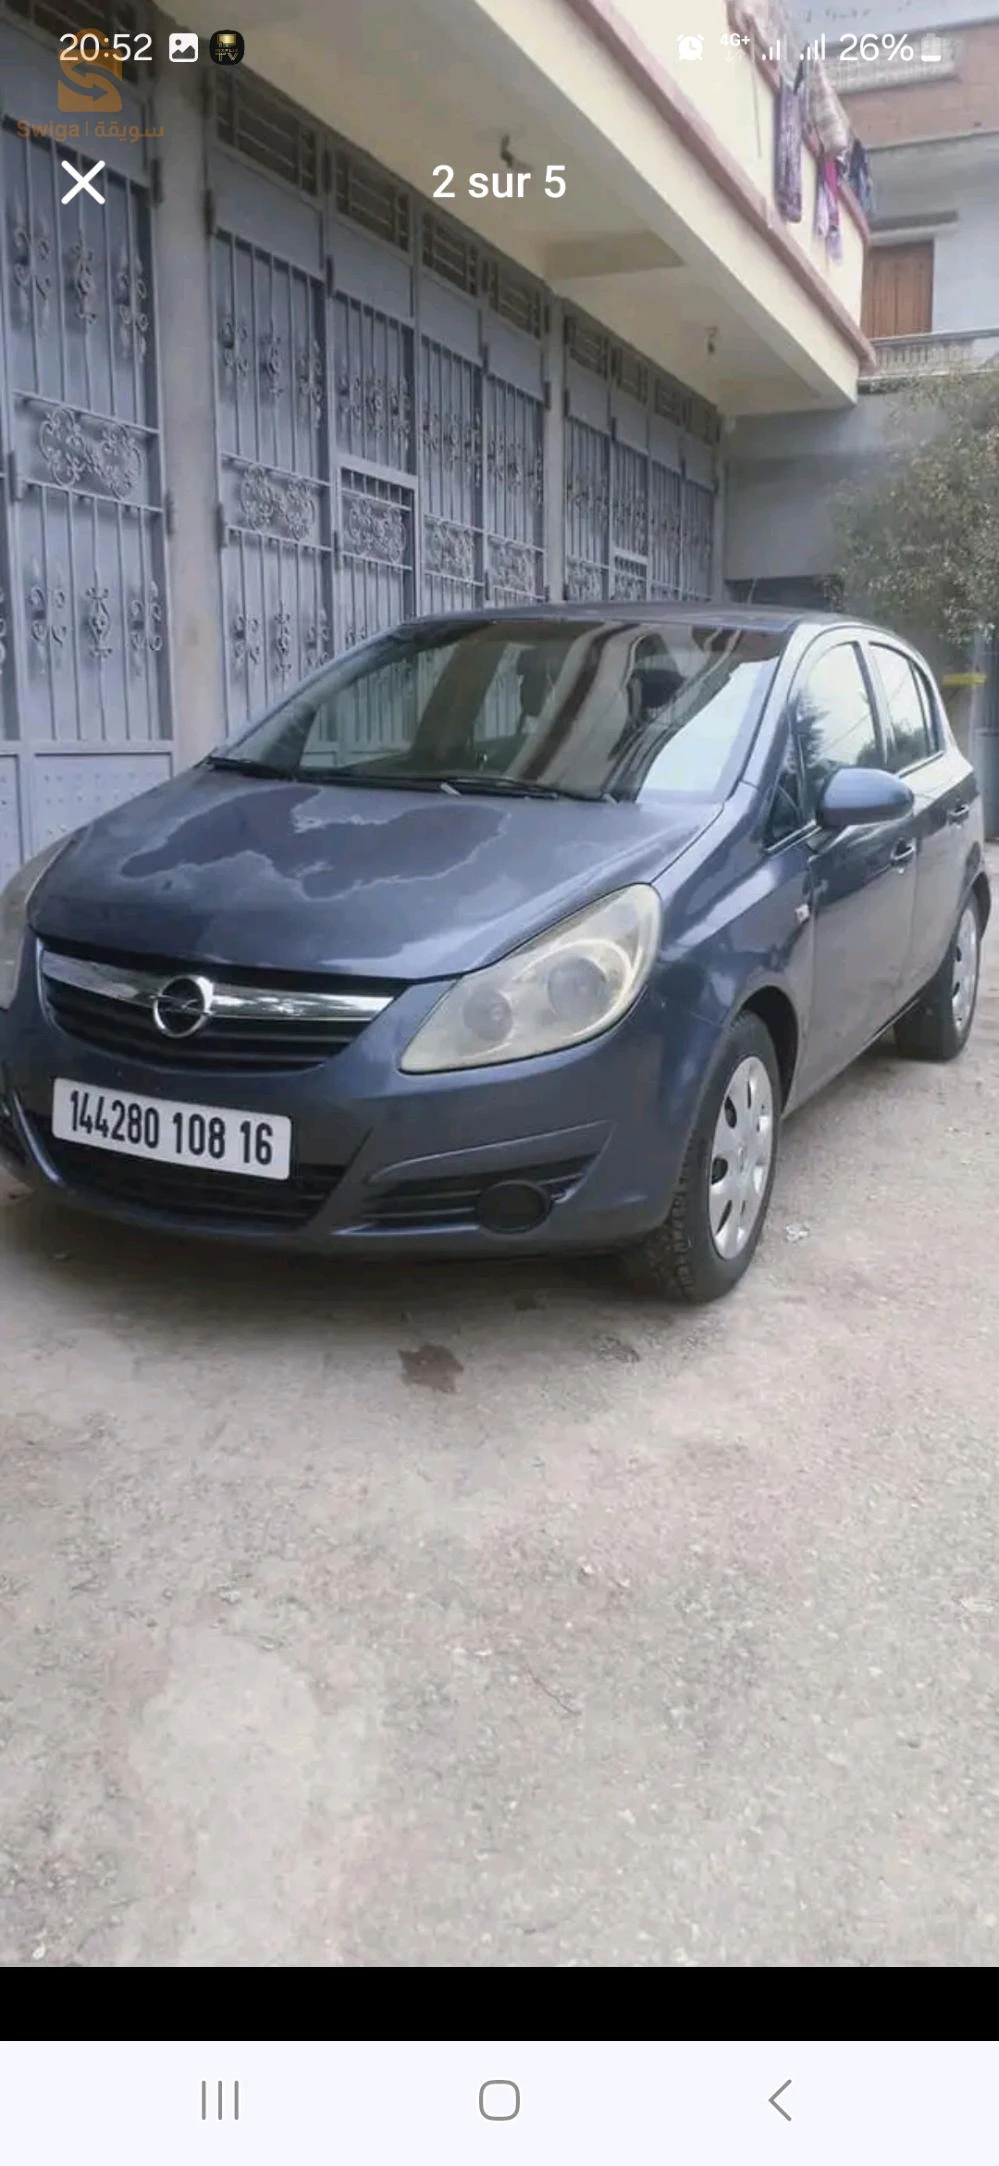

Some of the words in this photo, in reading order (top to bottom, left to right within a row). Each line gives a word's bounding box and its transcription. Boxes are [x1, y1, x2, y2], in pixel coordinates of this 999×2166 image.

[70, 1090, 160, 1149] 144280
[172, 1112, 226, 1159] 108
[240, 1121, 273, 1165] 16
